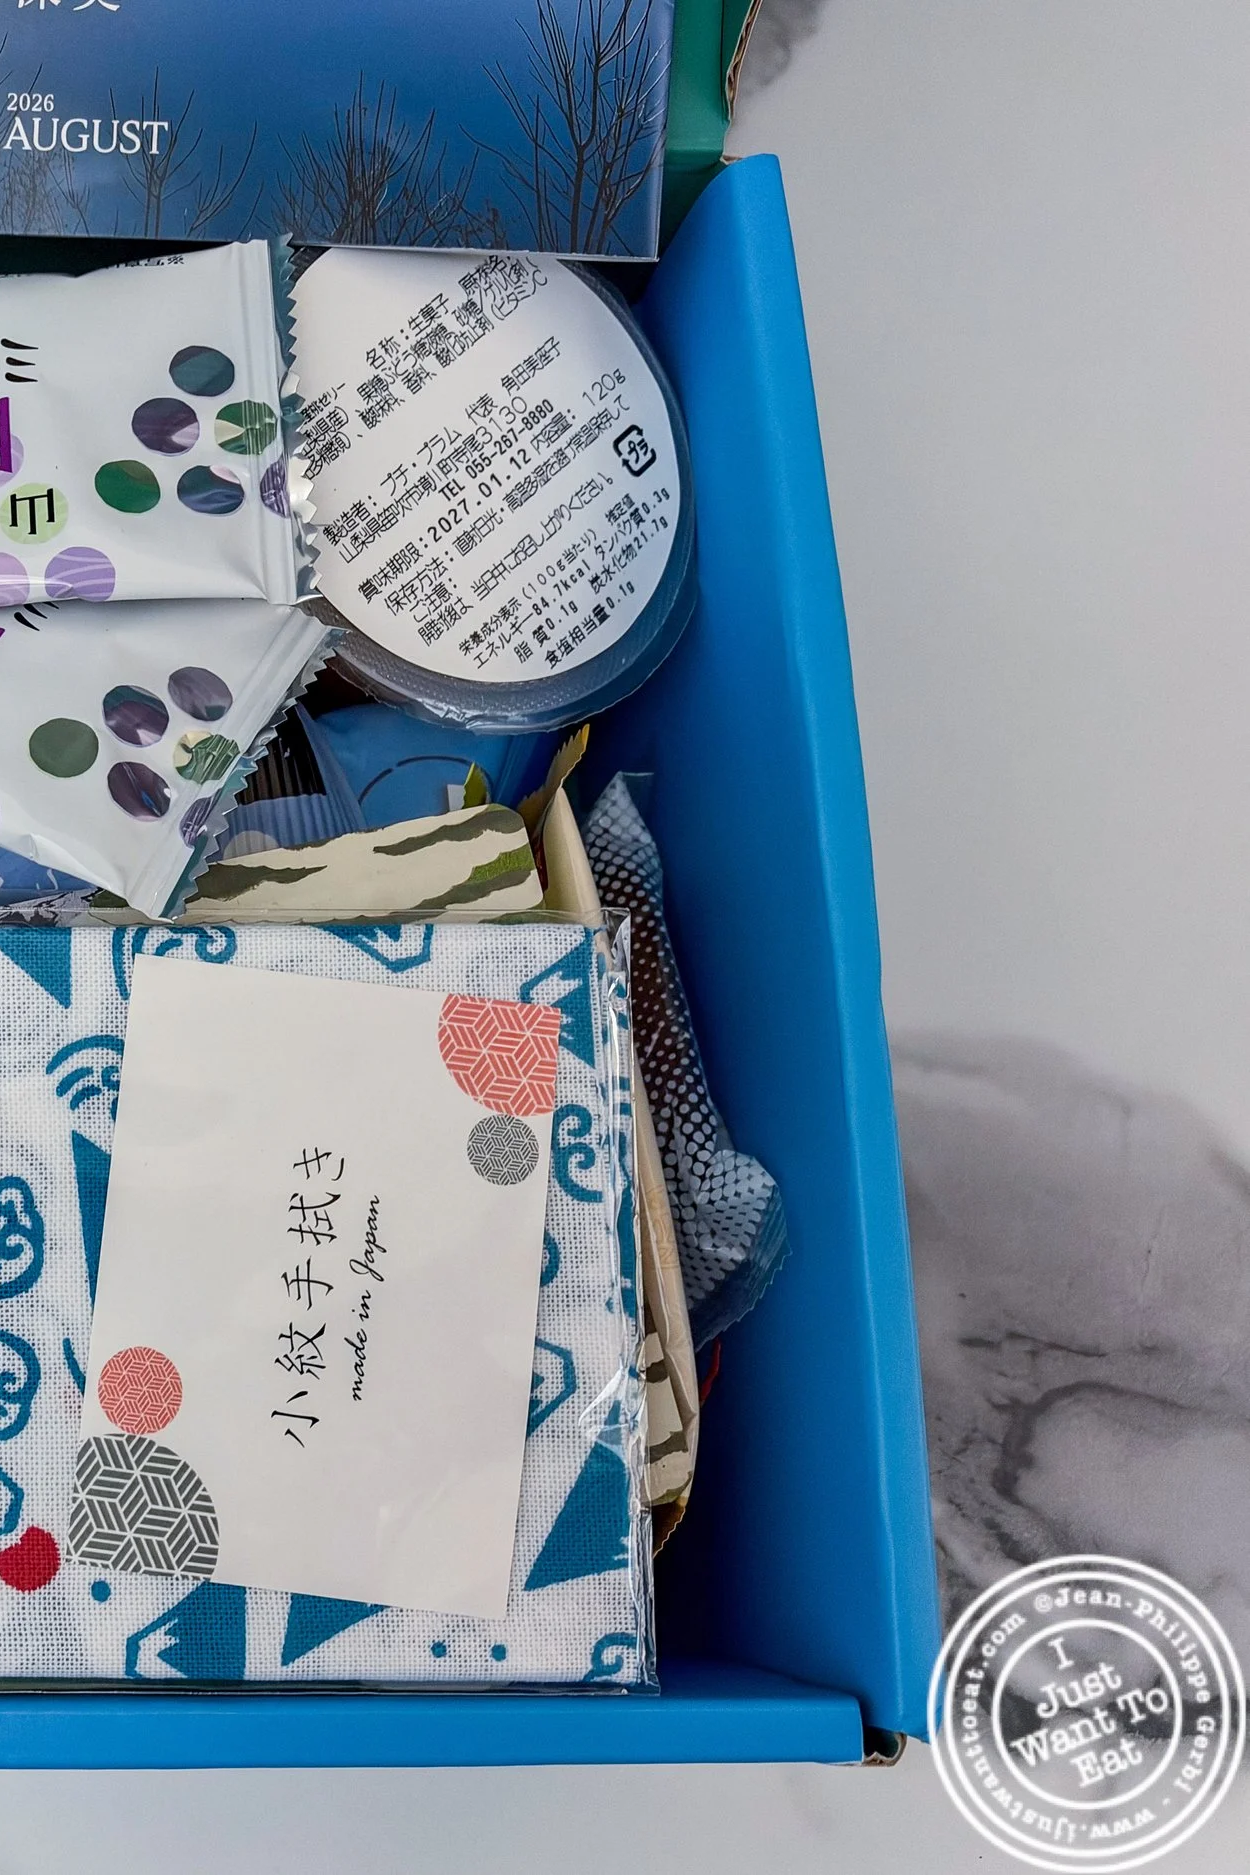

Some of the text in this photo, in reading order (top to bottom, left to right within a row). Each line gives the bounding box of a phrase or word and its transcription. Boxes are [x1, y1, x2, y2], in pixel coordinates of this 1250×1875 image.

[6, 93, 55, 112] 2026
[3, 117, 169, 155] AUGUST
[582, 368, 626, 407] 120g
[464, 392, 499, 426] 代表
[437, 398, 554, 502] TEL 055-267-8880
[270, 1146, 345, 1449] 小紋手拭き
[344, 1195, 388, 1402] made in Japan
